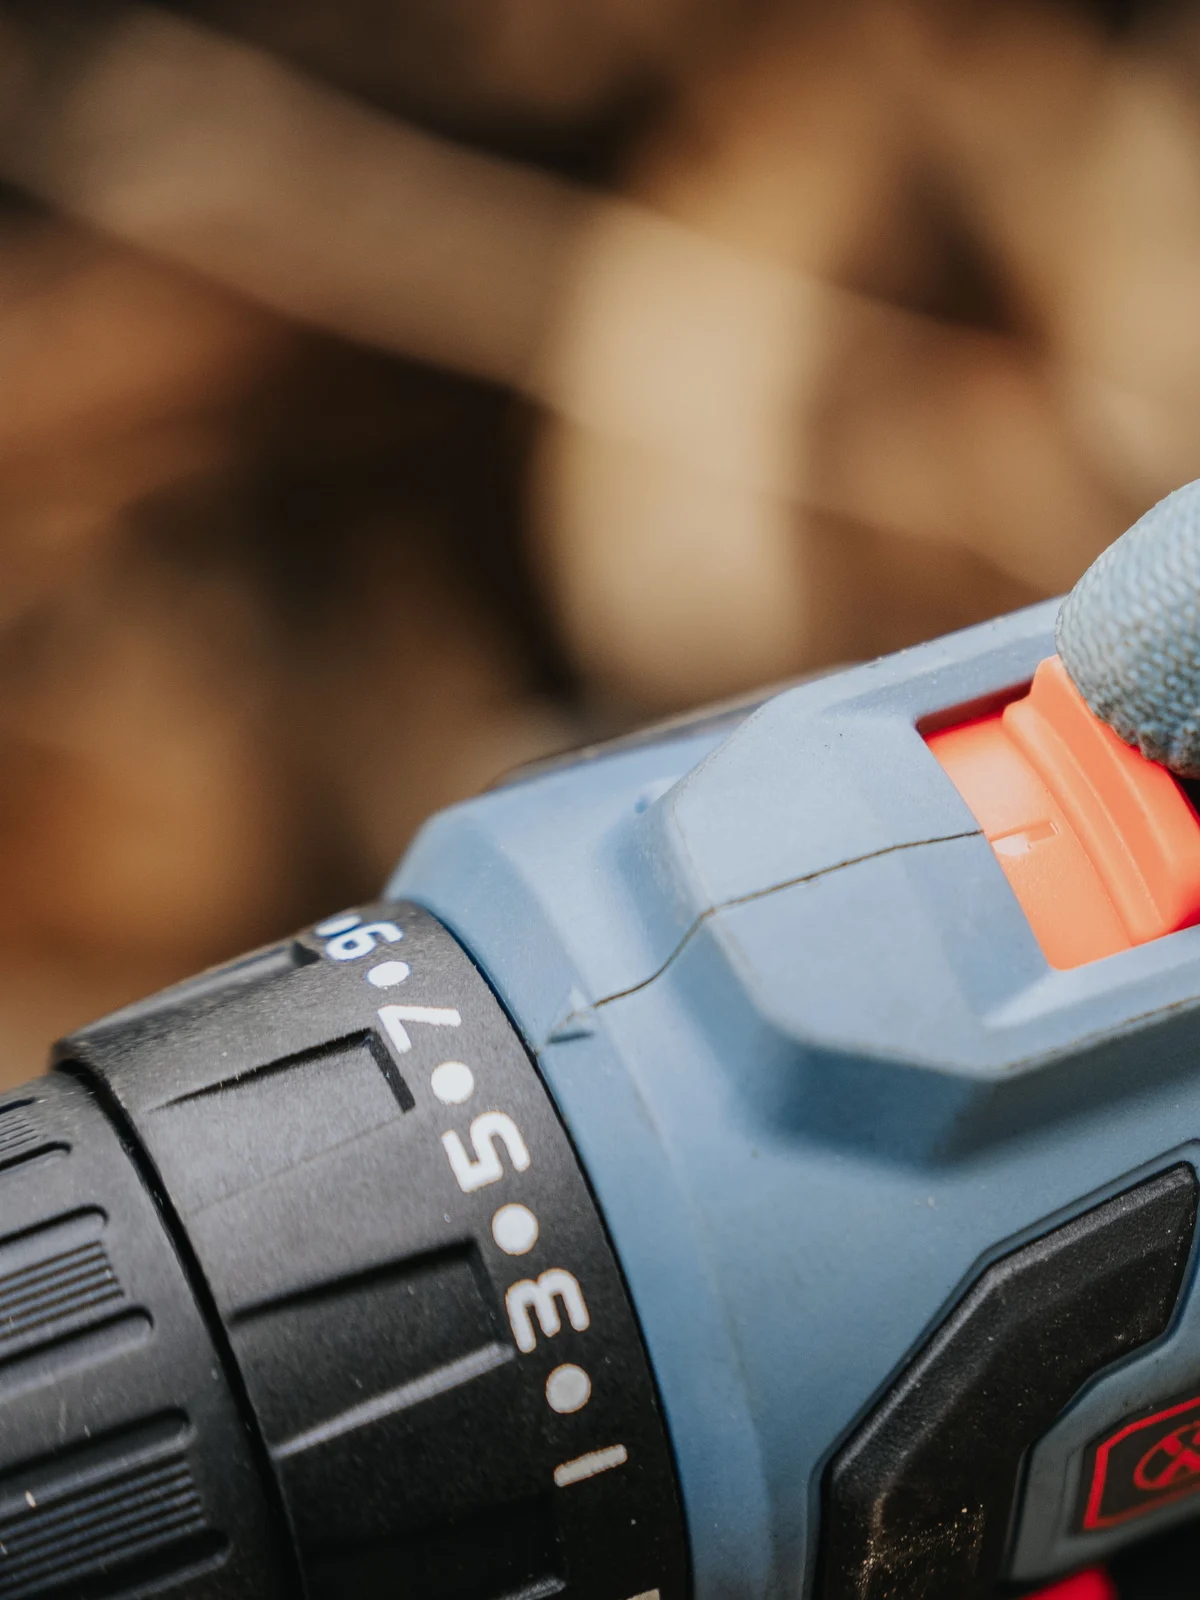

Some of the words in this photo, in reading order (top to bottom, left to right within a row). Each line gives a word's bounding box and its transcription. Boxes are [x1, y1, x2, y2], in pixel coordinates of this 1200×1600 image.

[377, 1004, 462, 1053] 7
[441, 1110, 531, 1193] 5
[505, 1268, 590, 1353] 3
